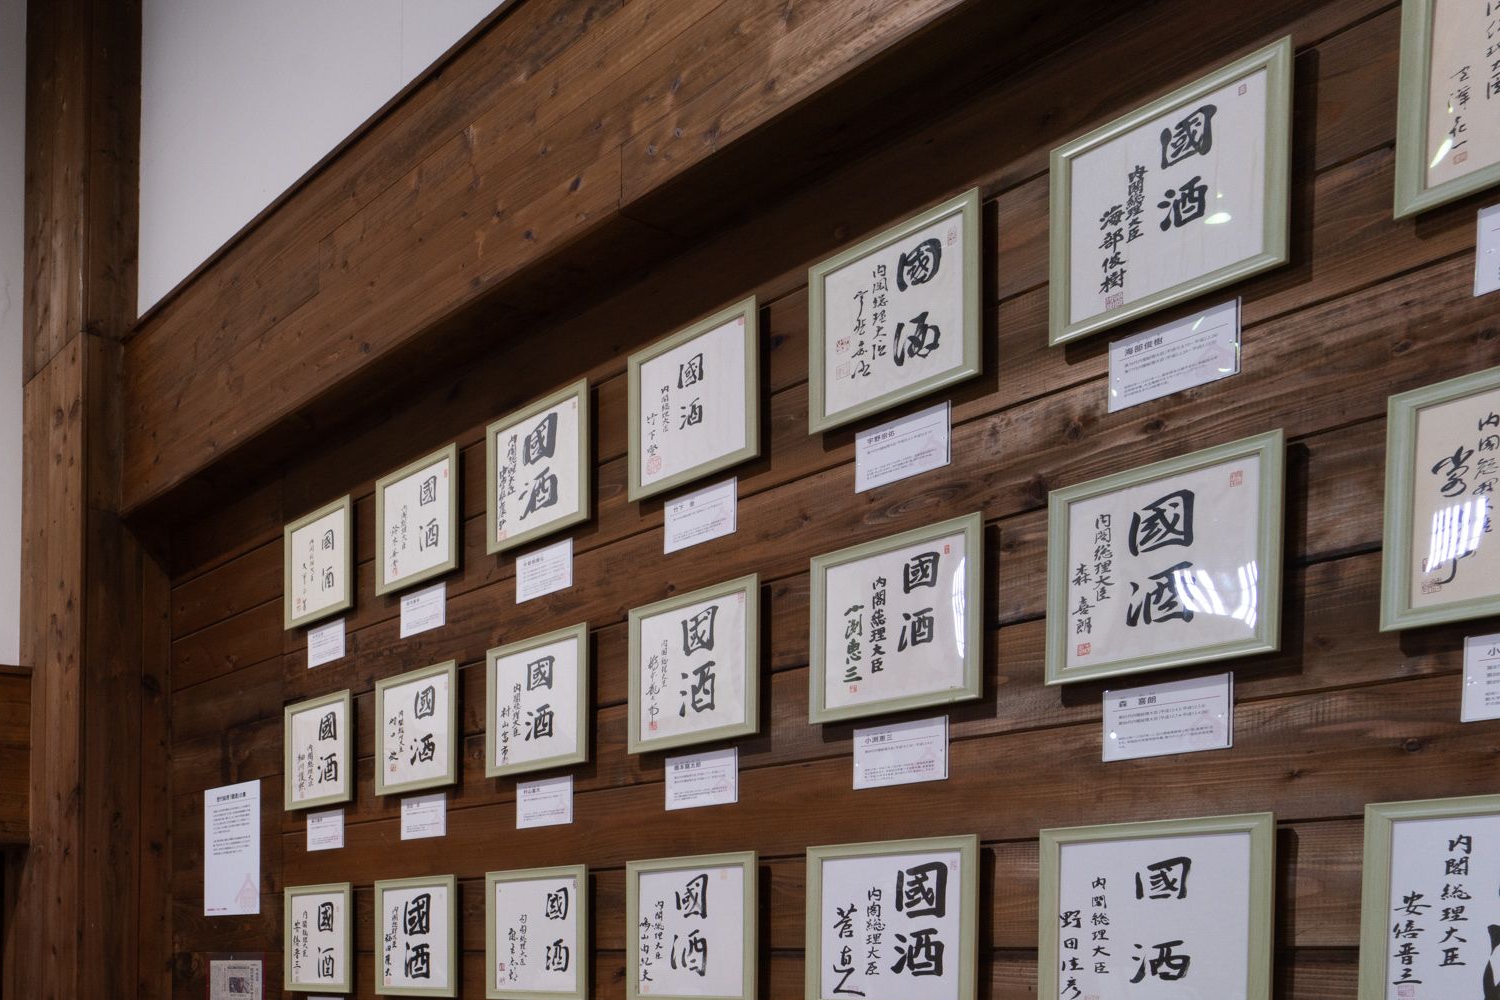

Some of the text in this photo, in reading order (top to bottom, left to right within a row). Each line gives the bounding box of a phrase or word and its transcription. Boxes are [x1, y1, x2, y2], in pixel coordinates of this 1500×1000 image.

[1157, 104, 1217, 232] 國酒
[1099, 204, 1126, 295] 海部俊樹
[677, 353, 704, 431] 國酒
[519, 412, 558, 521] 國酒
[897, 551, 940, 653] 國酒
[524, 655, 556, 742] 國酒
[679, 605, 719, 718] 國酒
[317, 711, 338, 784] 國酒
[410, 685, 436, 766] 國酒
[317, 901, 335, 979] 國酒
[403, 892, 431, 980] 國酒
[545, 886, 570, 973] 國酒
[670, 873, 709, 977] 國酒
[891, 861, 948, 977] 國酒
[1130, 856, 1192, 984] 國酒
[1392, 890, 1432, 985] 安倍晋三
[1439, 834, 1472, 968] 内閣総理大臣
[1059, 909, 1084, 1000] 野田佳彦
